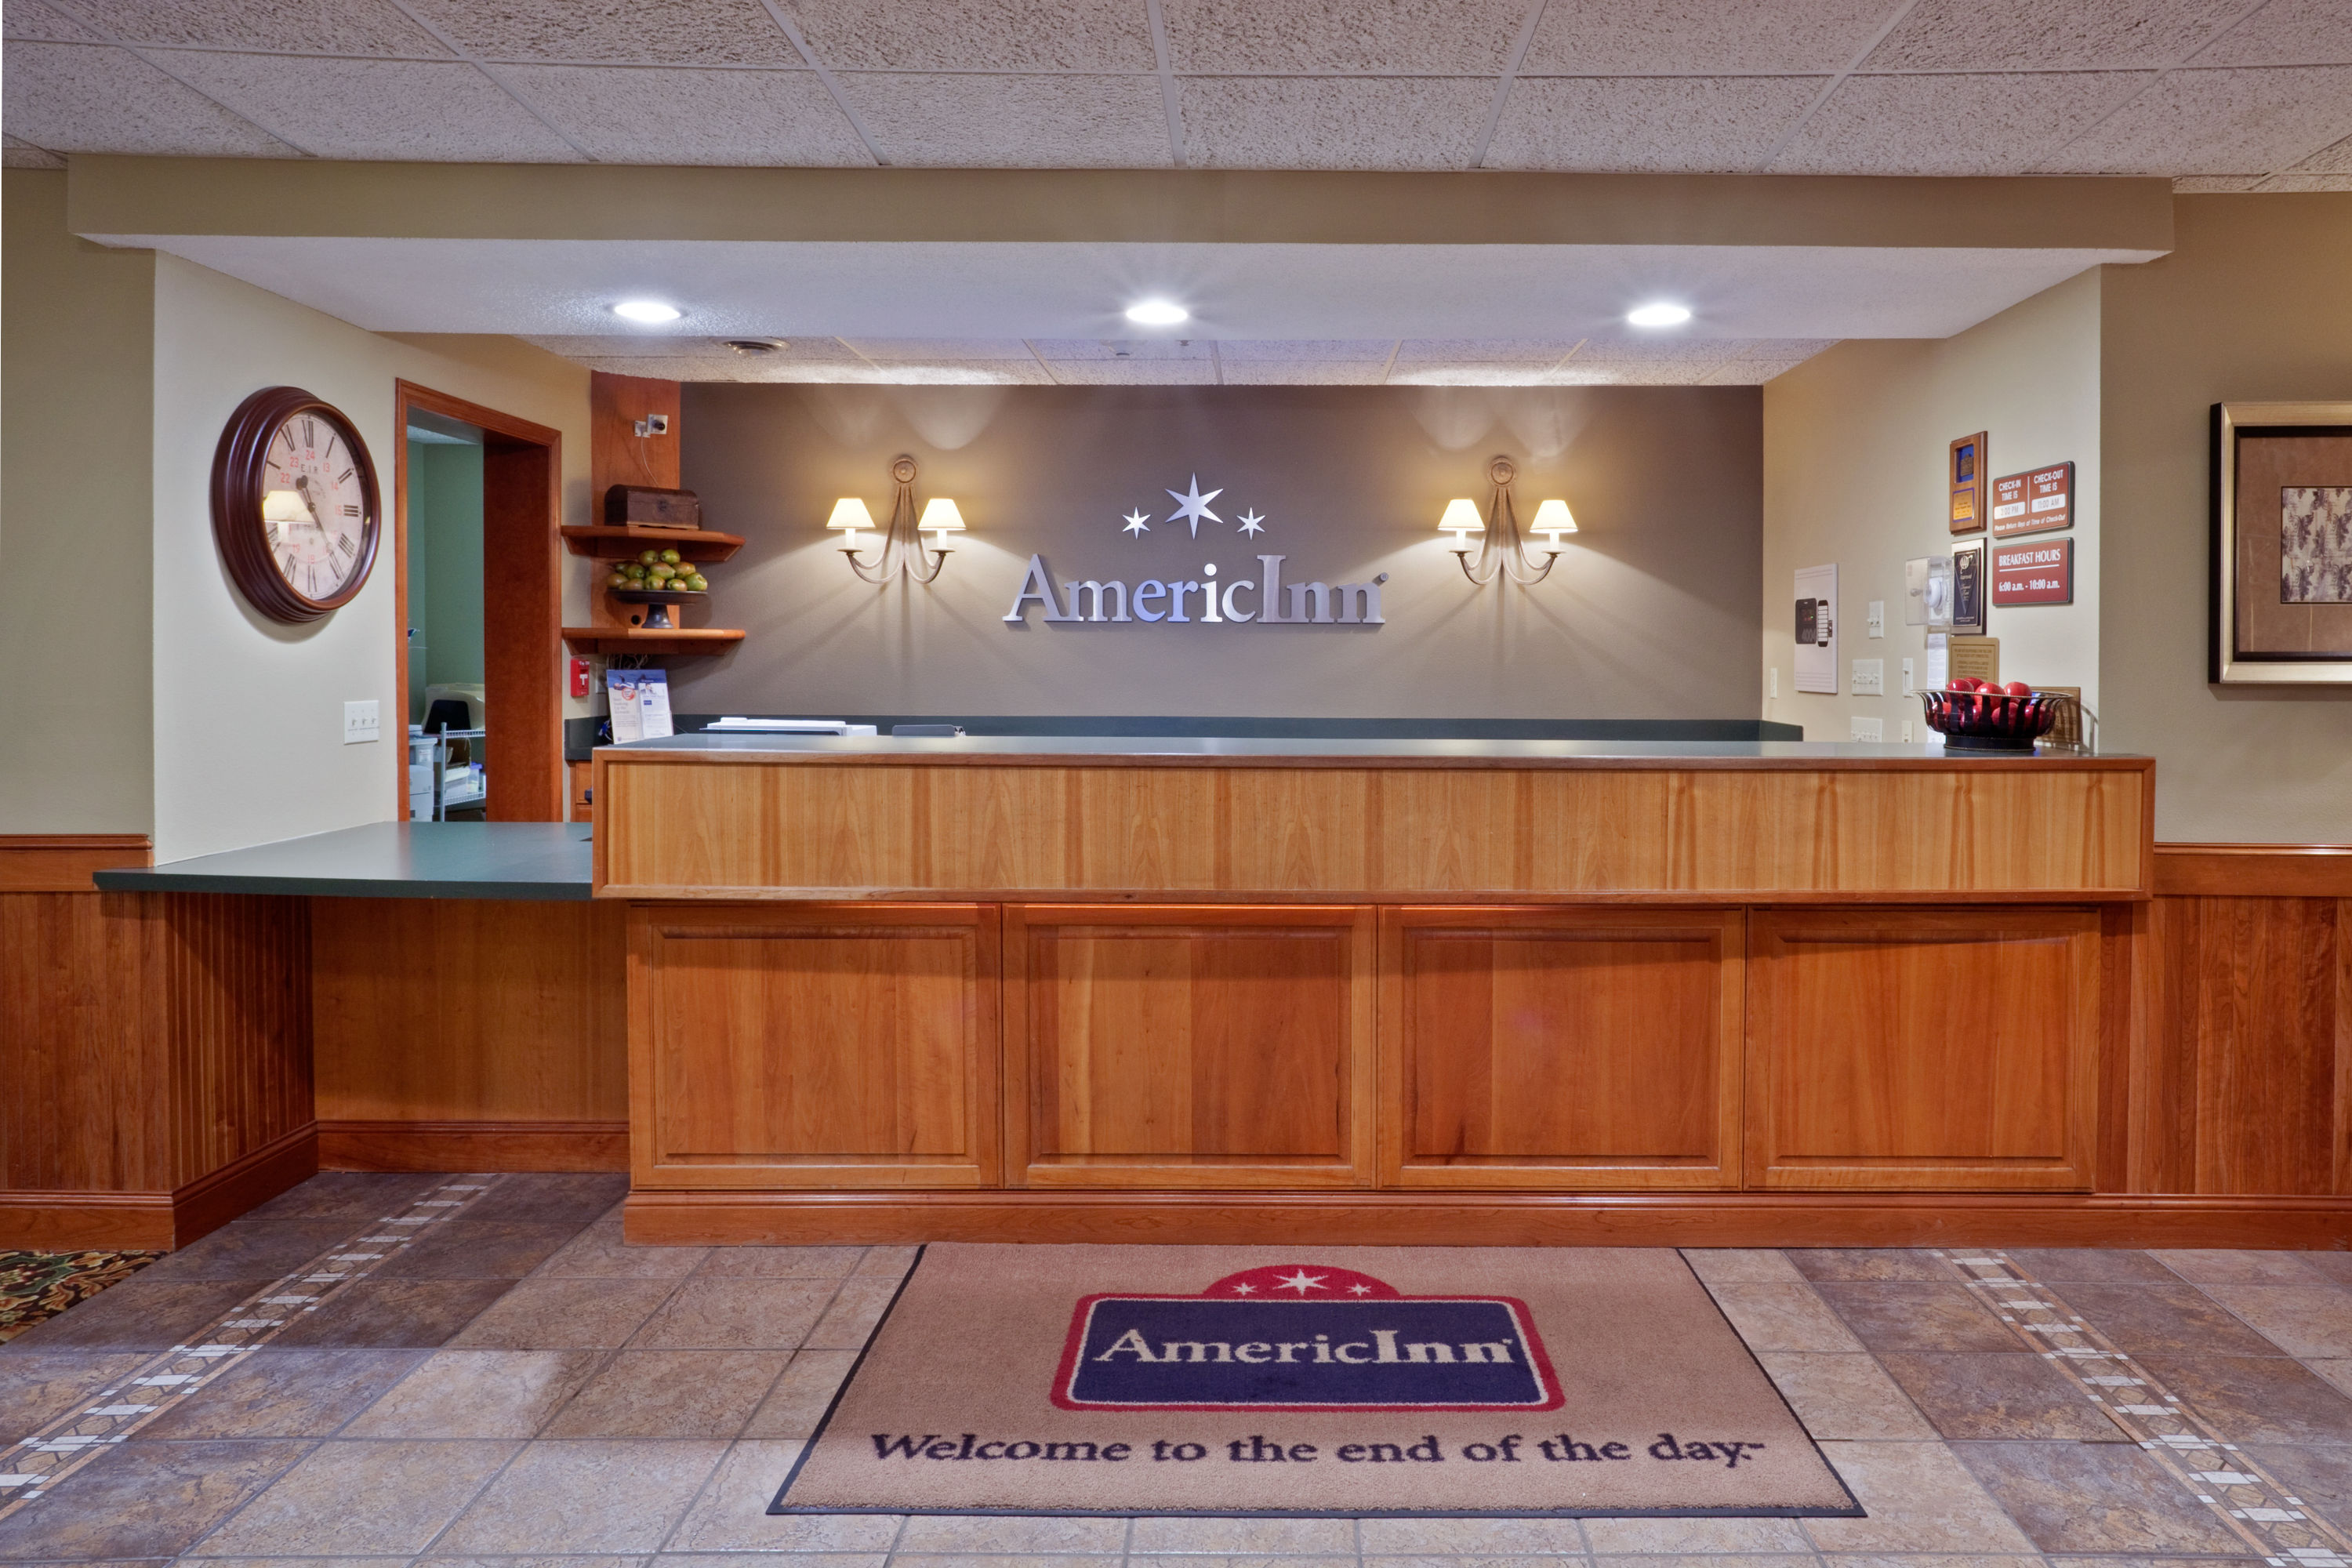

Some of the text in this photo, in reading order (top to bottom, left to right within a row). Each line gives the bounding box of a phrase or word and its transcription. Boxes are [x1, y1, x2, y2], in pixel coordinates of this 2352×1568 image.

[305, 449, 315, 460] 24
[289, 456, 299, 468] 23
[323, 463, 330, 473] 13
[280, 472, 290, 484] 22
[2034, 470, 2063, 484] CHECK-OUT
[1998, 479, 2021, 492] CHECK-IN
[2039, 482, 2057, 493] TIME IS
[2002, 490, 2018, 501] TIME IS
[1998, 548, 2061, 567] BREAKFAST HOURS
[1002, 554, 1386, 624] AmericInn
[1998, 581, 2012, 592] 6:00
[2012, 583, 2024, 591] a.m.
[2030, 579, 2045, 590] 10:00
[2046, 580, 2060, 589] a.m.
[1094, 1328, 1518, 1364] AmericInn
[871, 1433, 1133, 1461] Welcome
[1151, 1439, 1207, 1462] to
[1226, 1436, 1319, 1463] the
[1336, 1435, 1445, 1463] end
[1461, 1434, 1523, 1463] of
[1537, 1434, 1633, 1462] the
